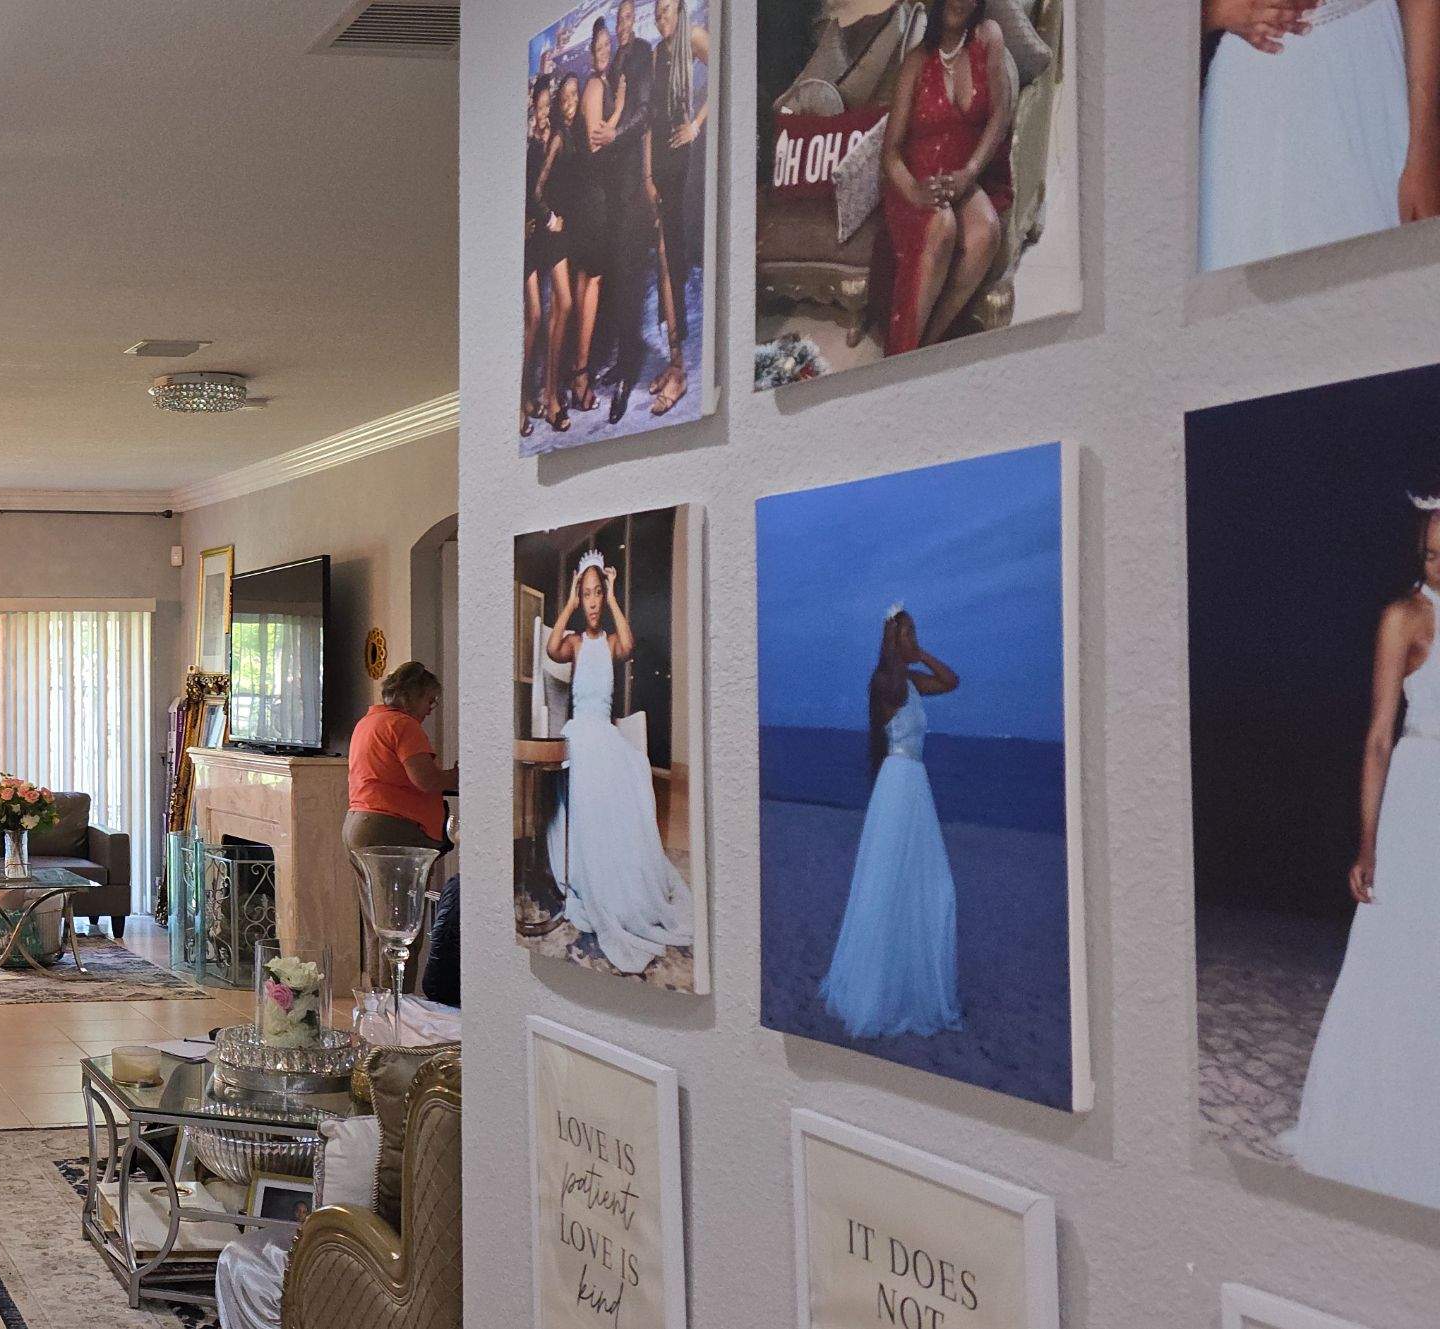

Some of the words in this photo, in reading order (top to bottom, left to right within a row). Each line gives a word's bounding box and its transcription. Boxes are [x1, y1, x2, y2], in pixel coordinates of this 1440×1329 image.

[774, 129, 804, 187] OH
[806, 132, 843, 183] OH
[557, 1110, 608, 1163] LOVE
[615, 1138, 636, 1176] IS
[561, 1161, 640, 1231] patient
[561, 1212, 613, 1270] LOVE
[620, 1247, 639, 1287] IS
[847, 1218, 876, 1263] IT
[889, 1237, 978, 1311] DOES
[576, 1263, 624, 1329] kind
[877, 1281, 945, 1329] NOT
